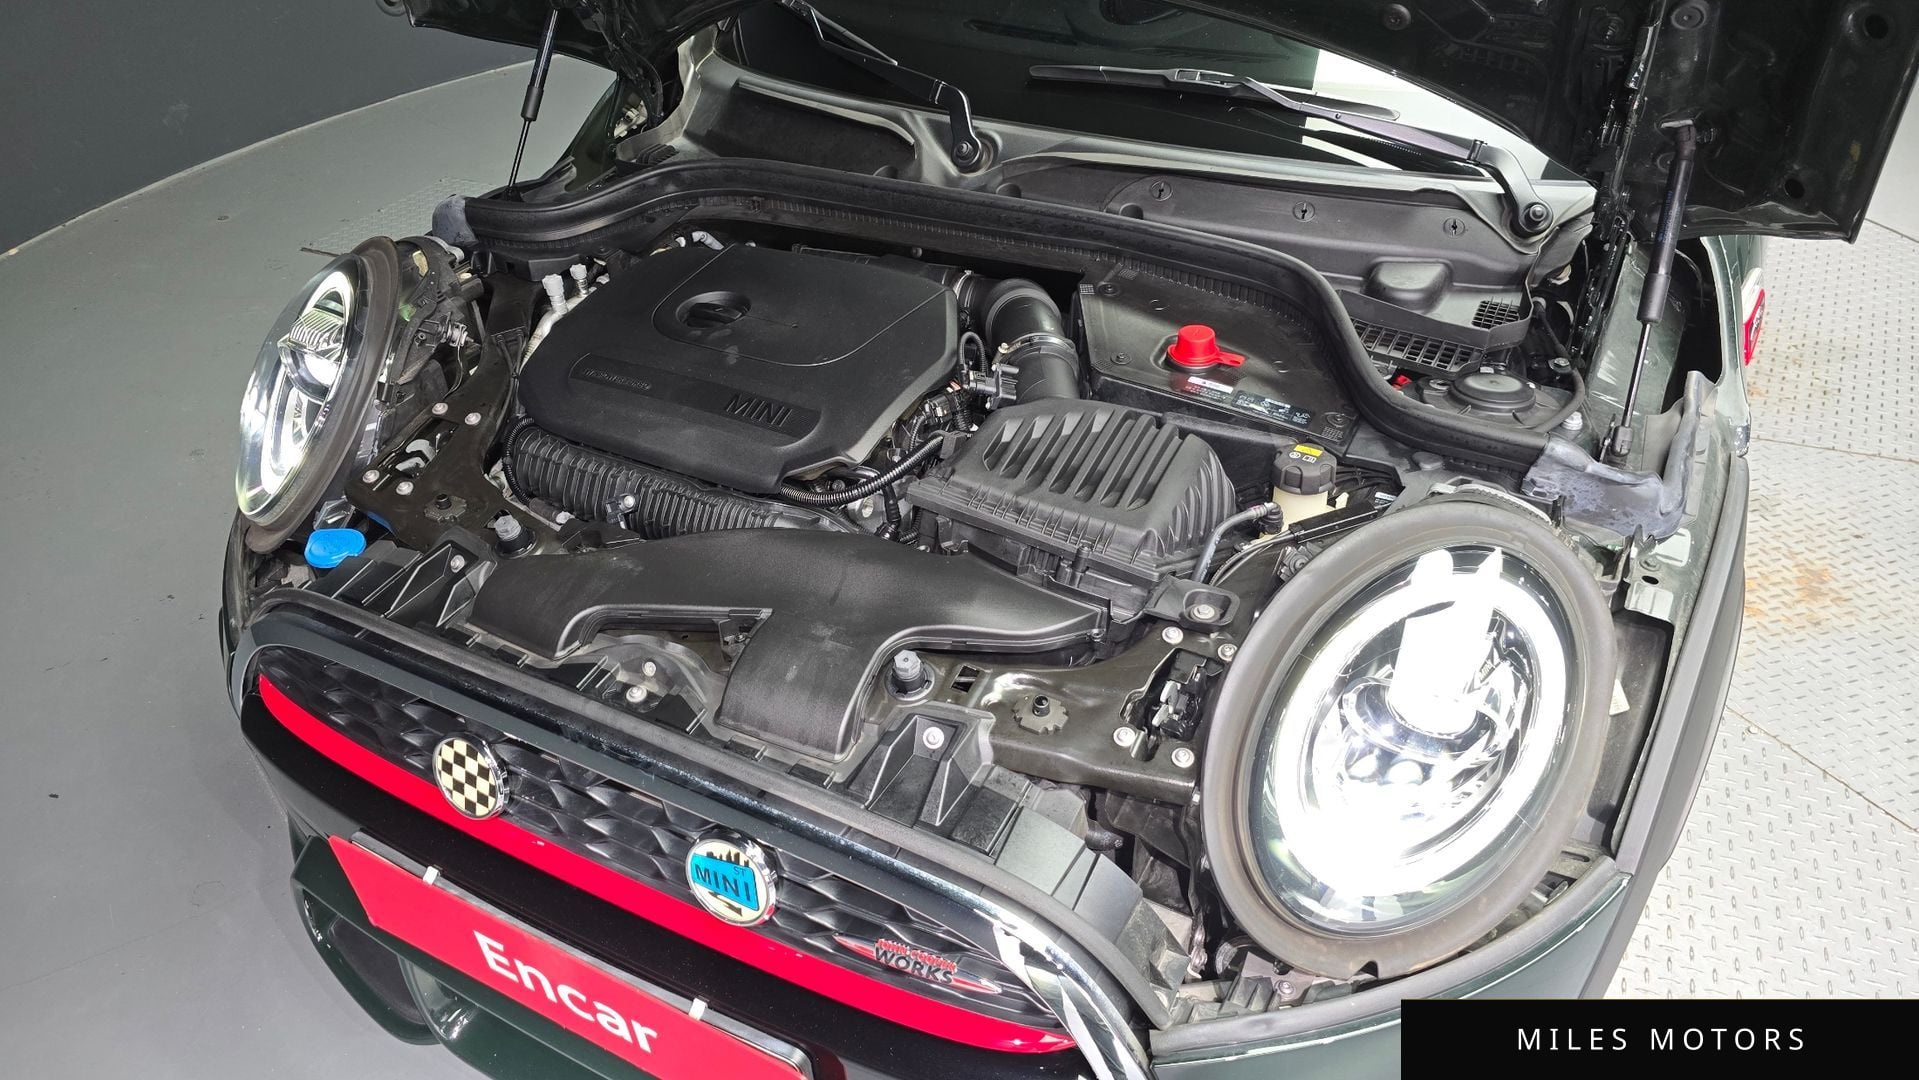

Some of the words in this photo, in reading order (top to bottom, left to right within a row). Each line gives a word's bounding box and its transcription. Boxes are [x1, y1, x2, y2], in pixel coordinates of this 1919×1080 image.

[725, 394, 792, 427] MINI
[695, 864, 751, 902] MINI
[875, 947, 954, 984] WORKS
[473, 930, 658, 1053] Encar
